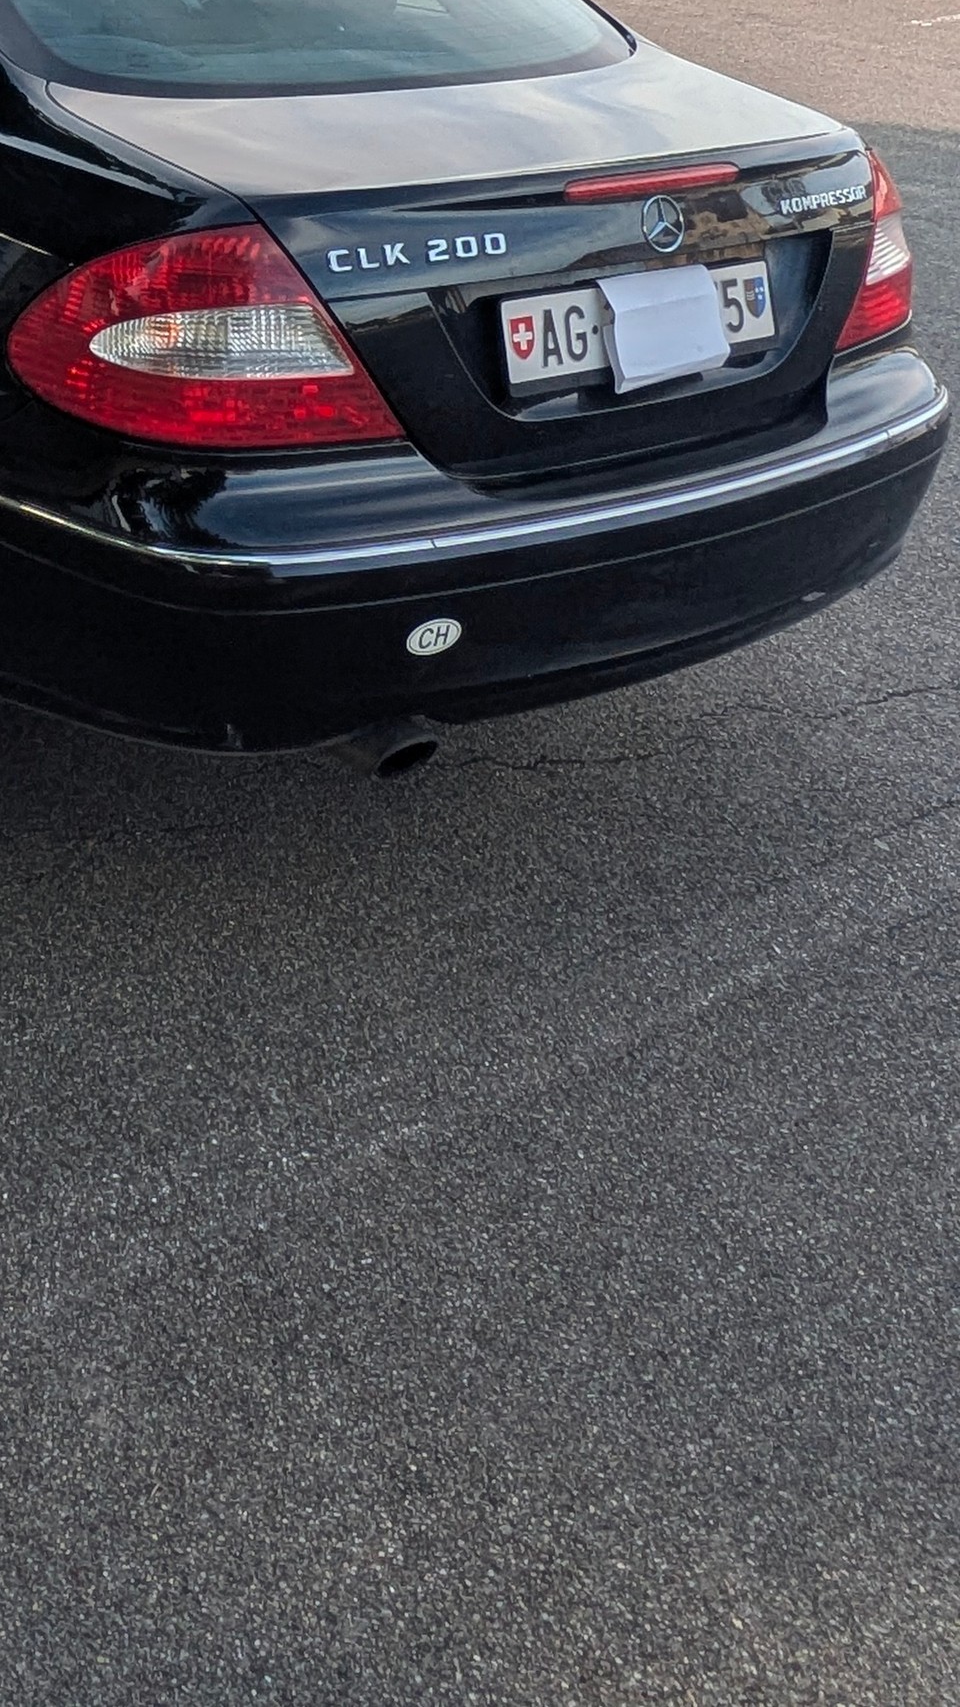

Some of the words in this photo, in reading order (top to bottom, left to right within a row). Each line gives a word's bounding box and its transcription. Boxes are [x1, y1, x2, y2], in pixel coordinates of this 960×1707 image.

[780, 185, 868, 215] KOMPRESSOR
[327, 242, 411, 273] CLK
[427, 232, 508, 263] 200
[419, 624, 451, 649] CH
